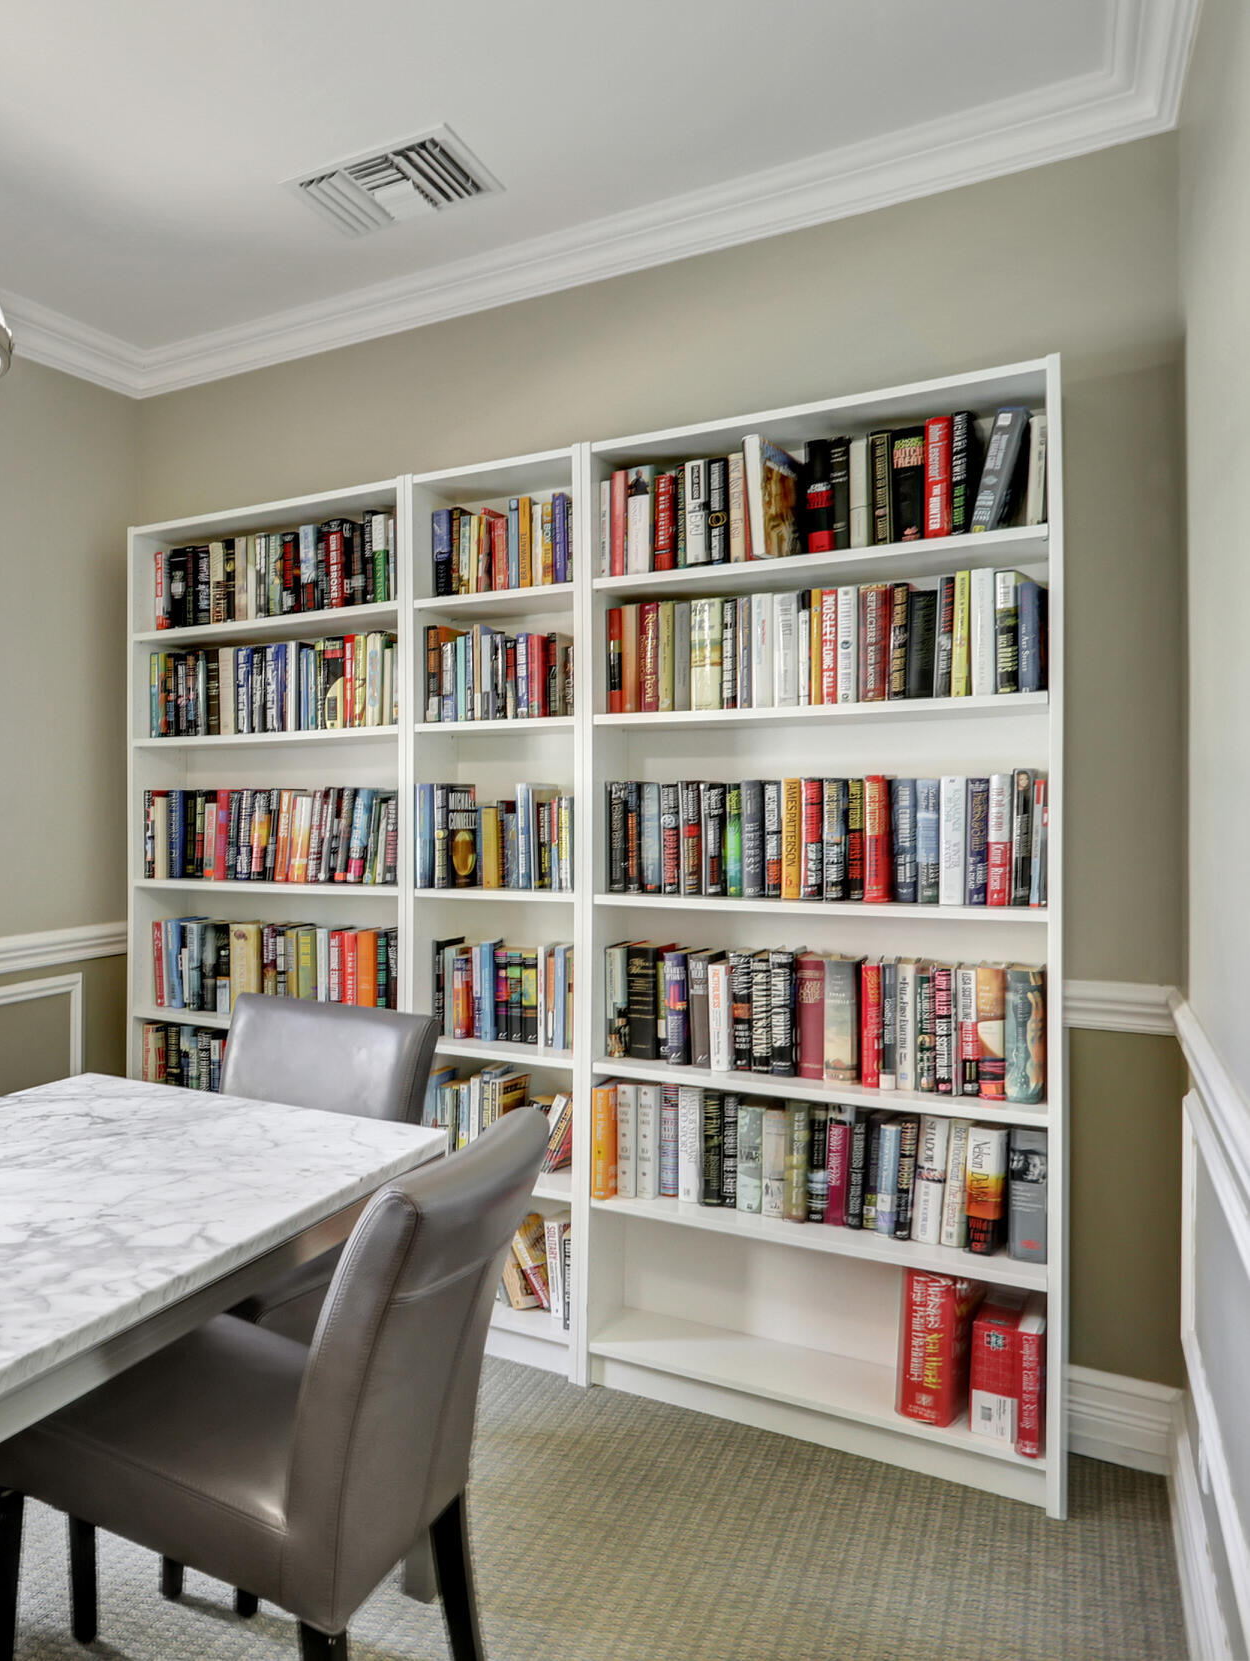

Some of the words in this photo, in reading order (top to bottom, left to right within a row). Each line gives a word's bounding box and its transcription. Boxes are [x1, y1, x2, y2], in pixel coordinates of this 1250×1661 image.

[930, 423, 944, 442] John
[953, 413, 964, 452] MICHAEL
[893, 446, 925, 460] DUTCH
[893, 456, 925, 469] TREAT
[928, 443, 944, 481] Lescroart
[952, 453, 964, 483] LEWIS
[658, 477, 668, 493] THE
[931, 484, 942, 496] THE
[953, 485, 964, 497] THE
[658, 496, 668, 510] BIG
[929, 497, 943, 531] HUNTER
[953, 497, 964, 507] BIG
[543, 522, 552, 544] BOX
[658, 512, 669, 547] PICTURE
[677, 510, 685, 541] KENYON
[330, 565, 339, 598] BROKE
[375, 551, 384, 601] QUENTINS
[780, 619, 792, 637] LOST
[823, 595, 835, 641] MOSLEY
[867, 592, 879, 643] SEPULCHRE
[977, 625, 986, 658] MICHELLE
[823, 647, 835, 669] LONG
[867, 646, 878, 665] KATE
[939, 650, 950, 674] REBEL
[998, 647, 1014, 672] ROADS
[823, 671, 835, 694] FALL
[867, 665, 878, 691] MOSSE
[977, 661, 986, 687] OBAMA
[644, 674, 657, 704] PEOPLE
[766, 783, 778, 801] JAMES
[786, 781, 798, 812] JAMES
[826, 782, 838, 801] JAMES
[848, 781, 861, 800] JAMES
[867, 781, 880, 802] JAMES
[898, 786, 910, 806] JOHN
[766, 802, 778, 832] PATTERSON
[826, 802, 838, 833] PATTERSON
[848, 800, 861, 830] PATTERSON
[867, 802, 880, 836] PATTERSON
[786, 813, 798, 868] PATTERSON
[898, 809, 910, 848] CONNOLLY
[664, 829, 676, 884] APPALOOSA
[745, 823, 756, 874] HERESY
[766, 835, 778, 860] DOUBLE
[827, 845, 839, 863] THE
[848, 832, 861, 860] CROSS
[952, 841, 961, 870] WINTER
[992, 843, 1004, 865] KATHY
[827, 864, 839, 883] INN
[848, 861, 861, 880] FIRE
[991, 867, 1004, 891] REICHS
[771, 969, 787, 1007] CAPITAL
[899, 982, 909, 997] FALL
[936, 971, 950, 989] LADY
[962, 972, 972, 988] LISA
[752, 972, 769, 1028] SULLIVAN'S
[899, 1001, 909, 1018] FIRST
[922, 983, 932, 1011] WILLARD
[935, 991, 949, 1016] KILLER
[961, 989, 972, 1021] SCOTTOLINE
[882, 998, 893, 1024] Goodbye
[922, 1012, 933, 1033] SCOTT
[771, 1008, 788, 1048] CRIMES
[899, 1019, 909, 1050] EXECUTIVE
[936, 1019, 949, 1035] LISA
[962, 1022, 974, 1041] KILLER
[751, 1028, 768, 1057] STING
[962, 1042, 974, 1061] SMILE
[935, 1036, 949, 1080] SCOTTOLINE
[680, 1089, 688, 1123] BLOOD
[688, 1091, 697, 1116] JAMES
[703, 1100, 720, 1118] AMY
[679, 1125, 688, 1154] SPORT
[703, 1119, 720, 1136] TAN
[830, 1126, 842, 1151] PENNY
[900, 1122, 914, 1154] STUART
[954, 1127, 966, 1142] Bob
[687, 1126, 697, 1164] STEWART
[923, 1121, 937, 1164] SHADOW
[971, 1139, 990, 1169] Nelson
[828, 1151, 842, 1187] VINCENZI
[898, 1157, 913, 1190] WOODS
[950, 1143, 964, 1181] Woodward
[922, 1183, 930, 1196] BOB
[950, 1185, 961, 1197] The
[919, 1197, 929, 1236] WOODWARD
[946, 1198, 959, 1228] Agenda
[547, 1226, 558, 1262] SOLITARY
[911, 1277, 931, 1305] Large
[911, 1306, 929, 1331] Print
[926, 1334, 944, 1353] New
[1020, 1336, 1034, 1370] Complete
[907, 1333, 928, 1381] Dictionary
[923, 1357, 944, 1388] World
[1021, 1370, 1034, 1393] Guide
[1019, 1403, 1034, 1430] Sewing
